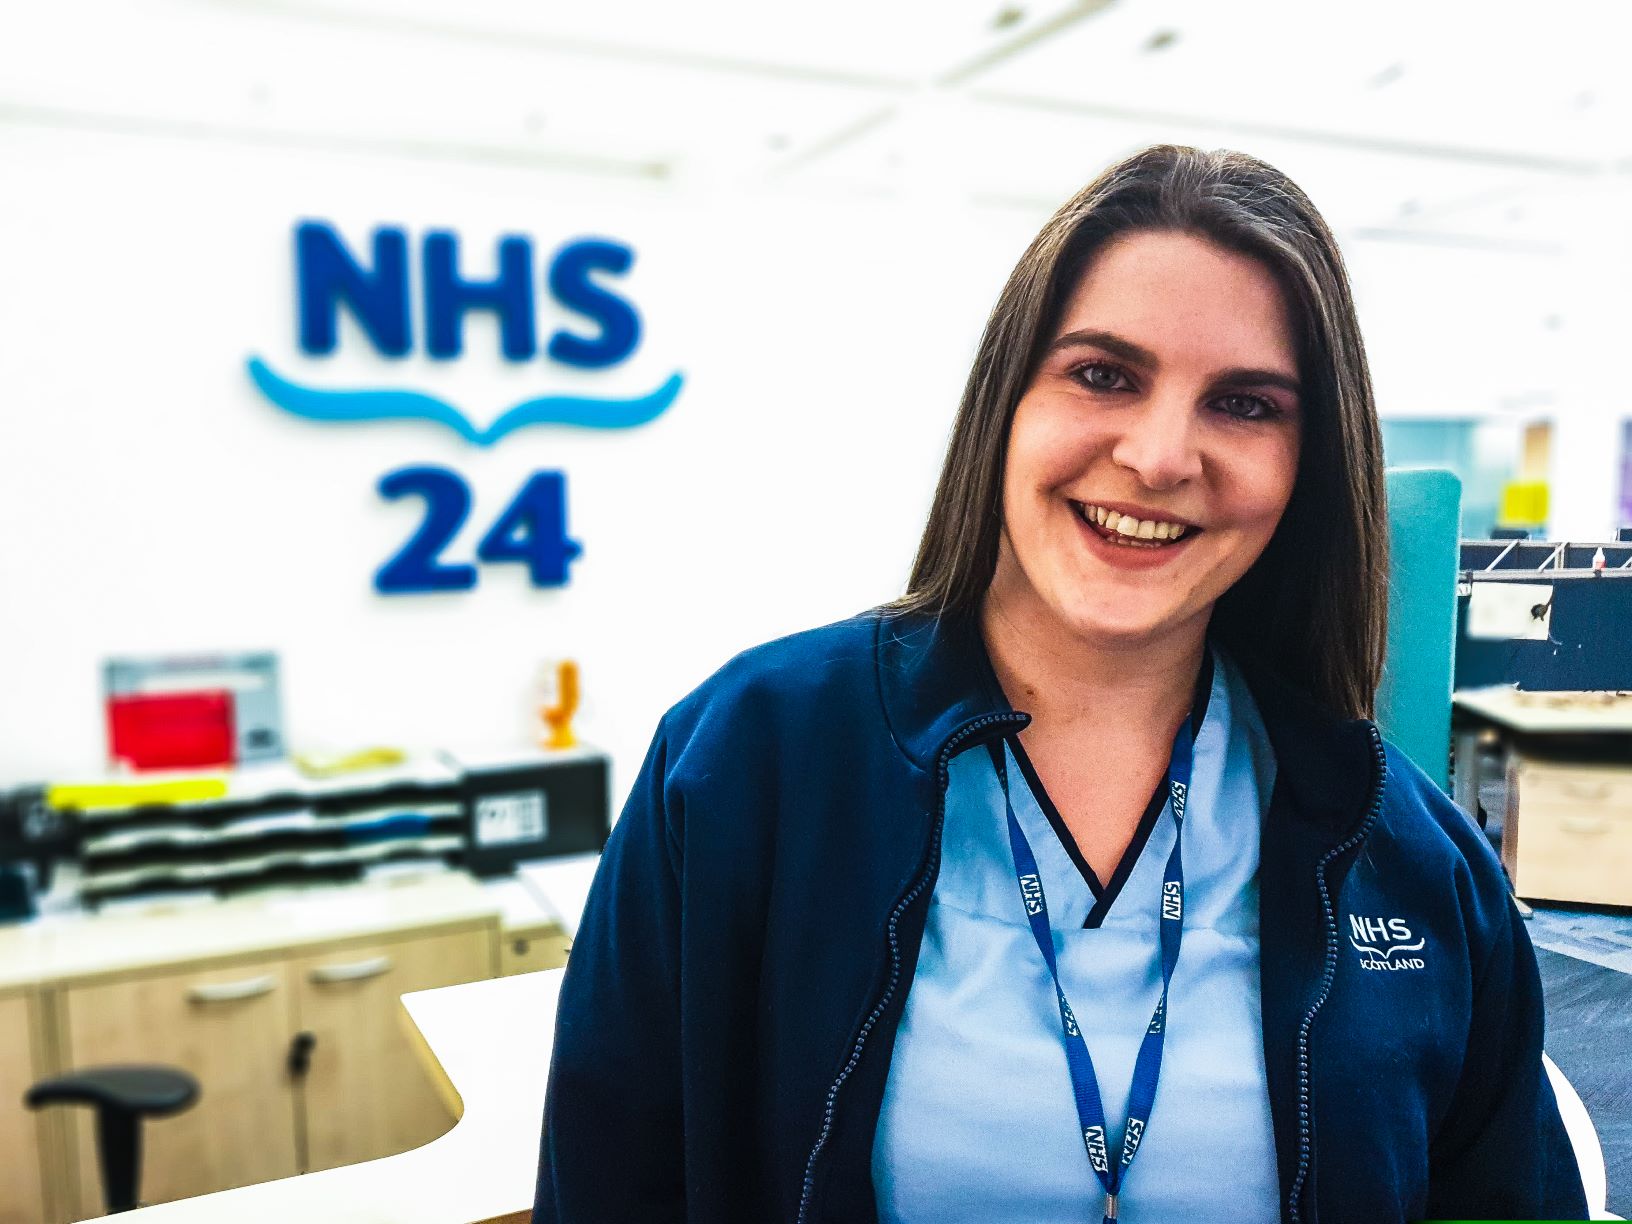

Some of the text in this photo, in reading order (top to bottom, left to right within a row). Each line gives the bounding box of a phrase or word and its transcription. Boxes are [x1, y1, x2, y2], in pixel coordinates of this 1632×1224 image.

[296, 219, 643, 370] NHS
[374, 463, 584, 594] 24
[1169, 781, 1187, 819] NHS
[1019, 874, 1043, 915] NHS
[1162, 881, 1181, 920] NHS
[1349, 914, 1412, 943] NHS
[1085, 1125, 1109, 1173] NHS
[1121, 1117, 1145, 1165] NHS
